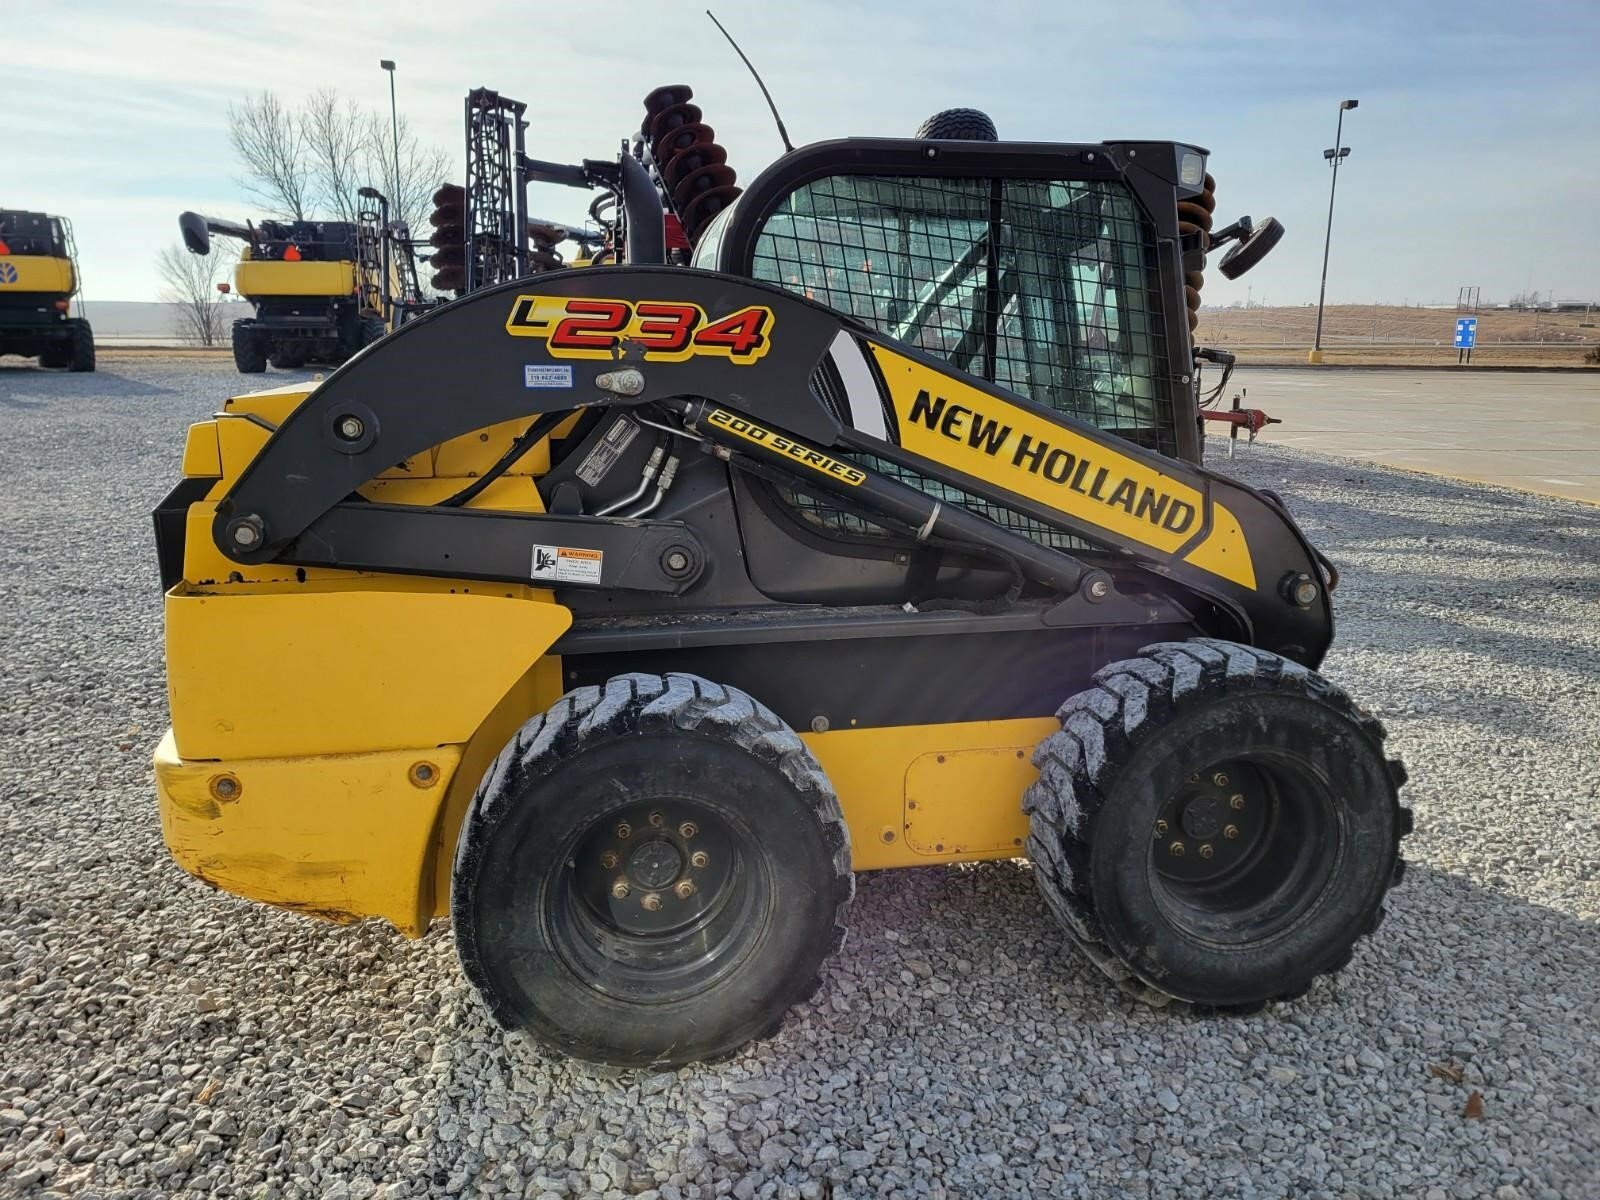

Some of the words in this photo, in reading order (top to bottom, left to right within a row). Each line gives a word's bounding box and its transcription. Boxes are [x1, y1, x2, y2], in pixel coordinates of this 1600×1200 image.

[711, 410, 767, 440] 200
[771, 437, 866, 483] SERIES
[908, 389, 1012, 456] NEW
[1011, 433, 1195, 535] HOLLAND
[568, 551, 598, 559] WARNING
